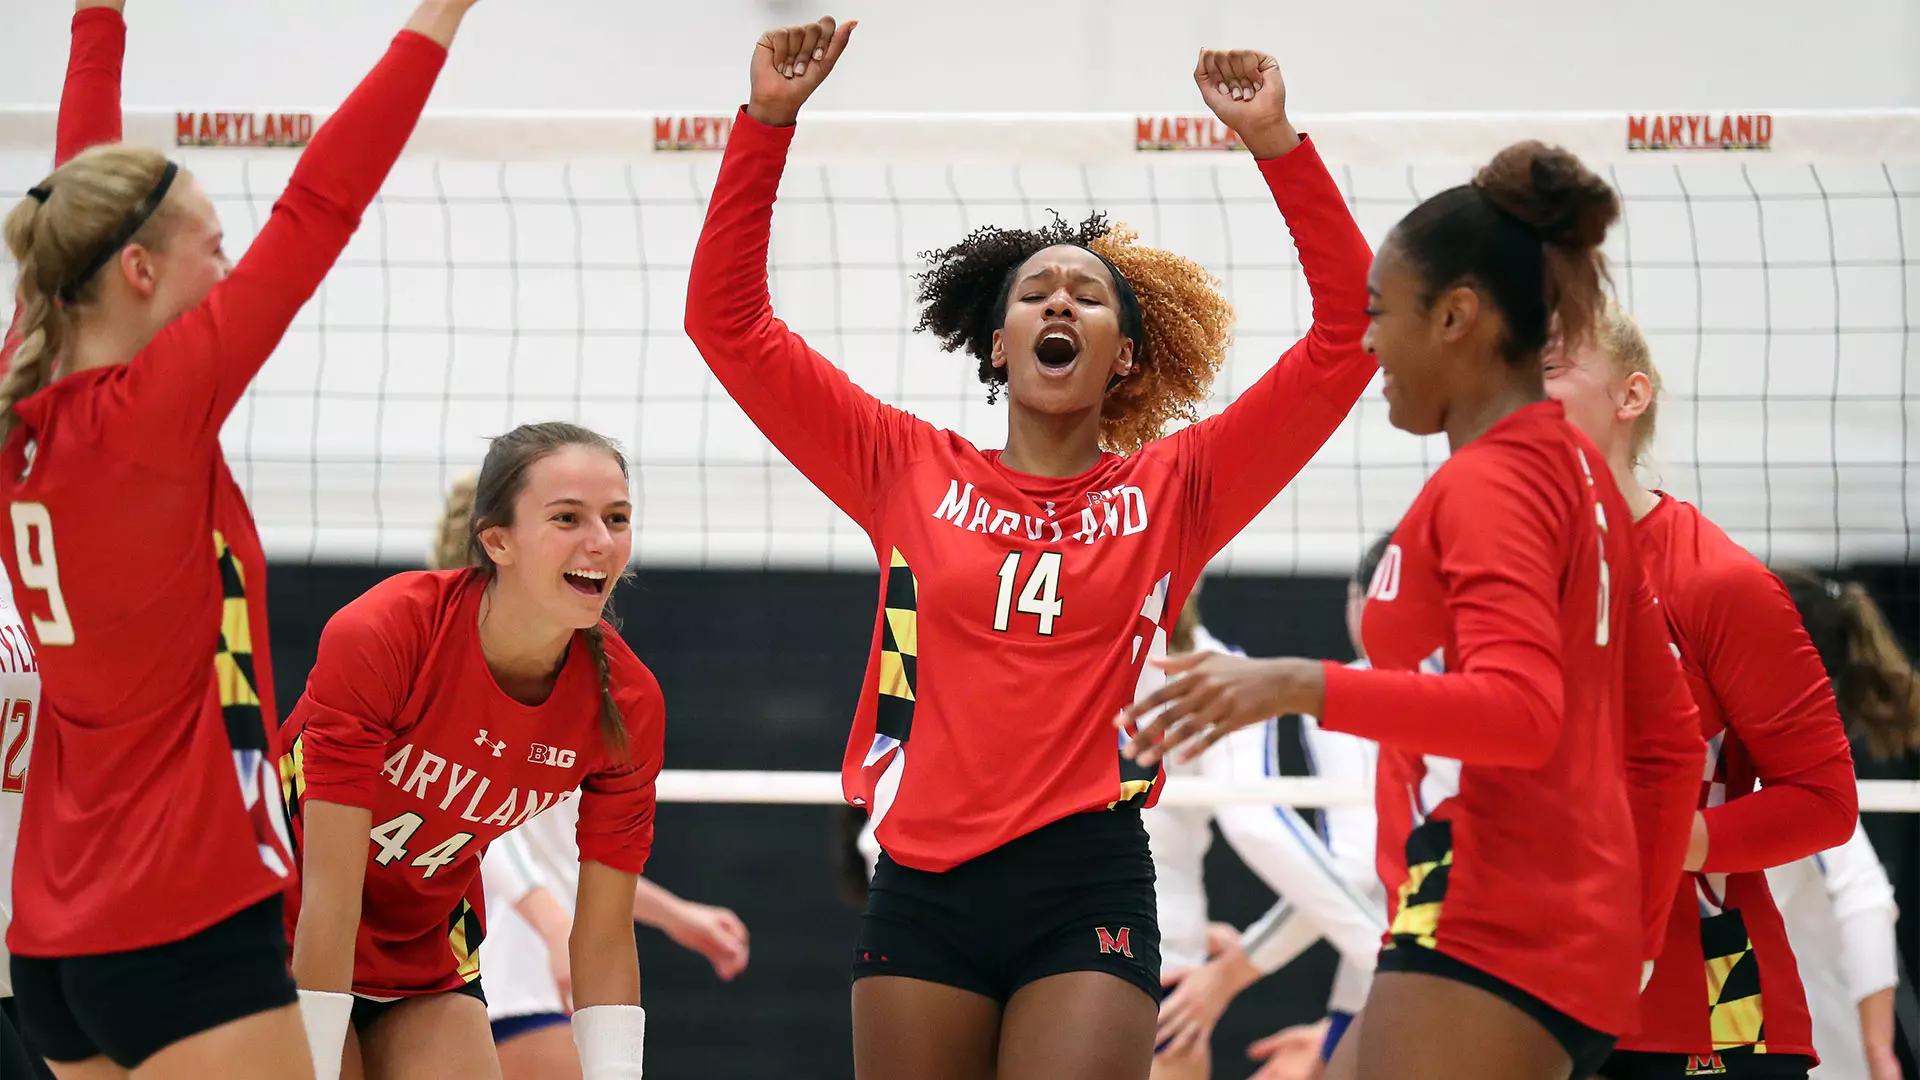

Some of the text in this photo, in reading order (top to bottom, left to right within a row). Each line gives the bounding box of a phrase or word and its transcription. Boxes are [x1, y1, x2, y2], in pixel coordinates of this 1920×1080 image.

[176, 112, 313, 143] MARYLAND
[1628, 115, 1772, 145] MARYLAND
[10, 501, 75, 645] 9
[992, 550, 1063, 636] 14
[370, 811, 475, 879] 44
[1095, 927, 1133, 958] M
